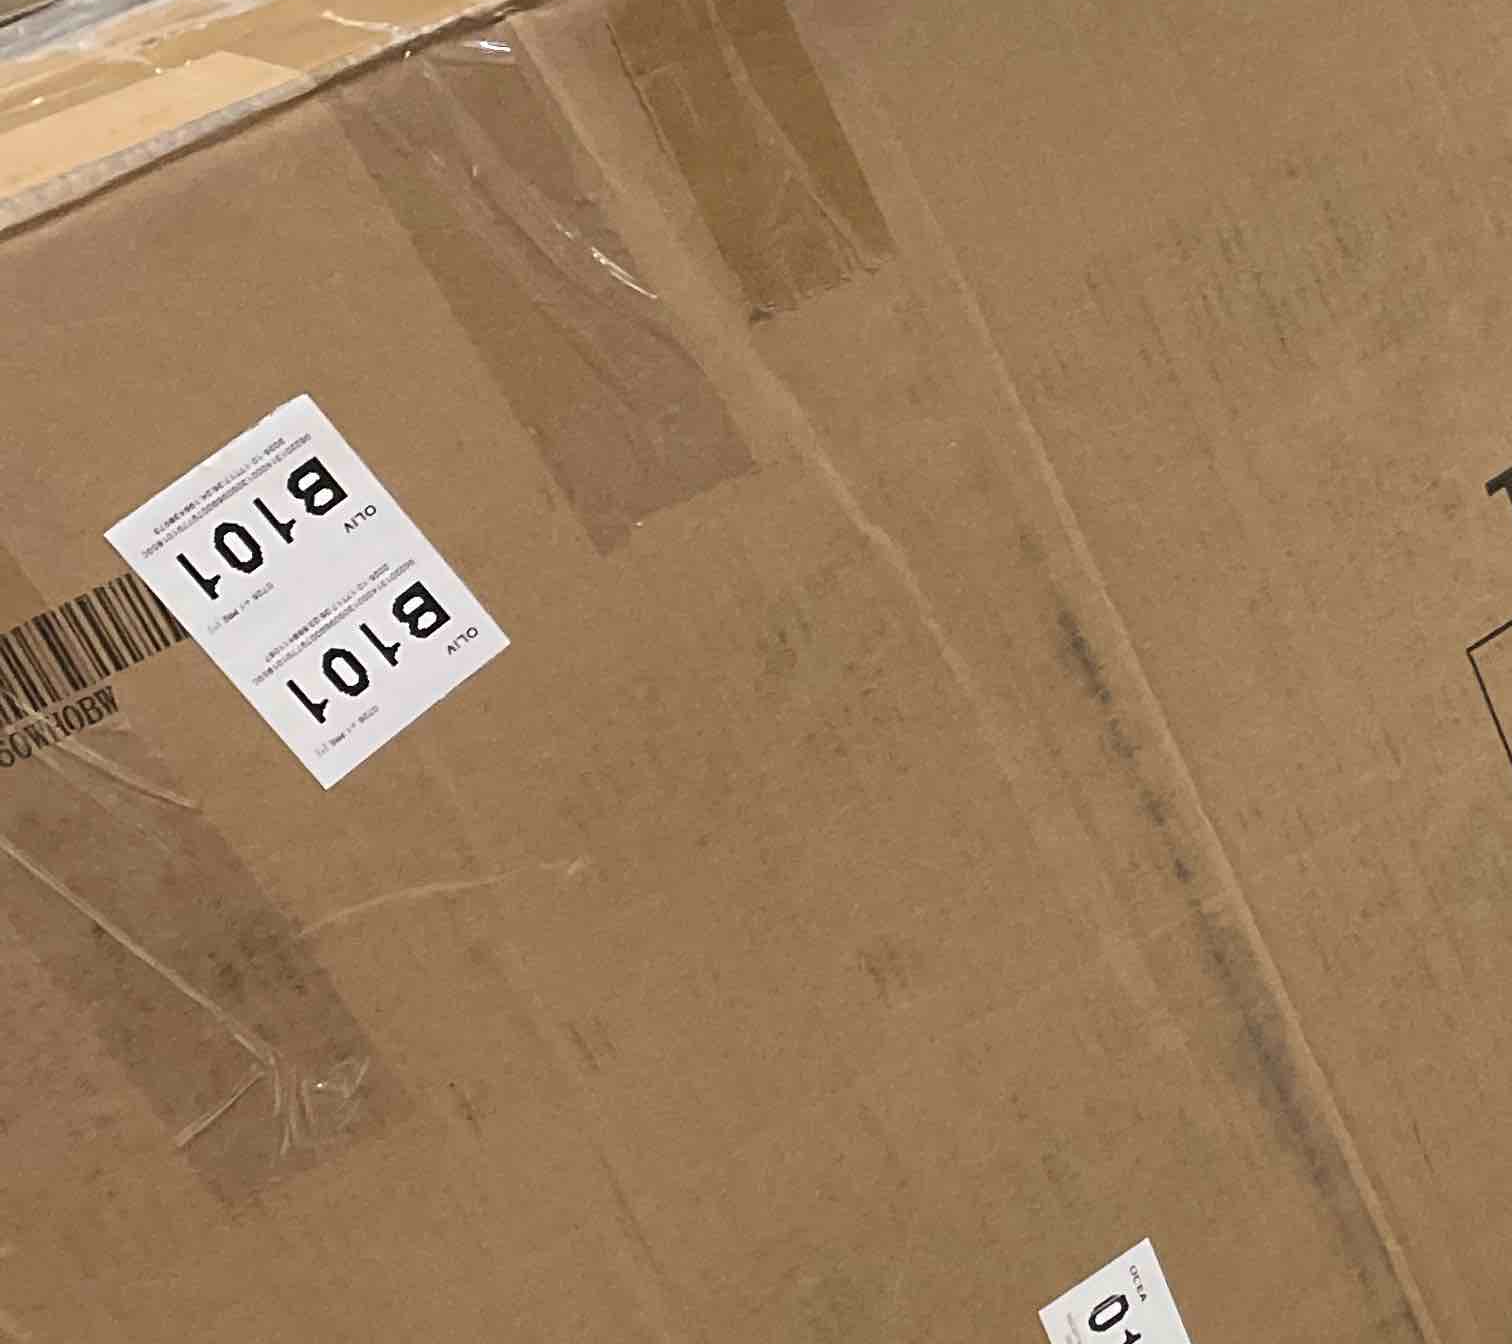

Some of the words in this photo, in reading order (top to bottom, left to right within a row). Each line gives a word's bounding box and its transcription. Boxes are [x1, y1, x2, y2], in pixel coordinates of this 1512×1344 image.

[176, 456, 349, 600] B101
[344, 504, 377, 533] OLIV
[286, 580, 451, 724] B101
[445, 625, 480, 655] OLIV
